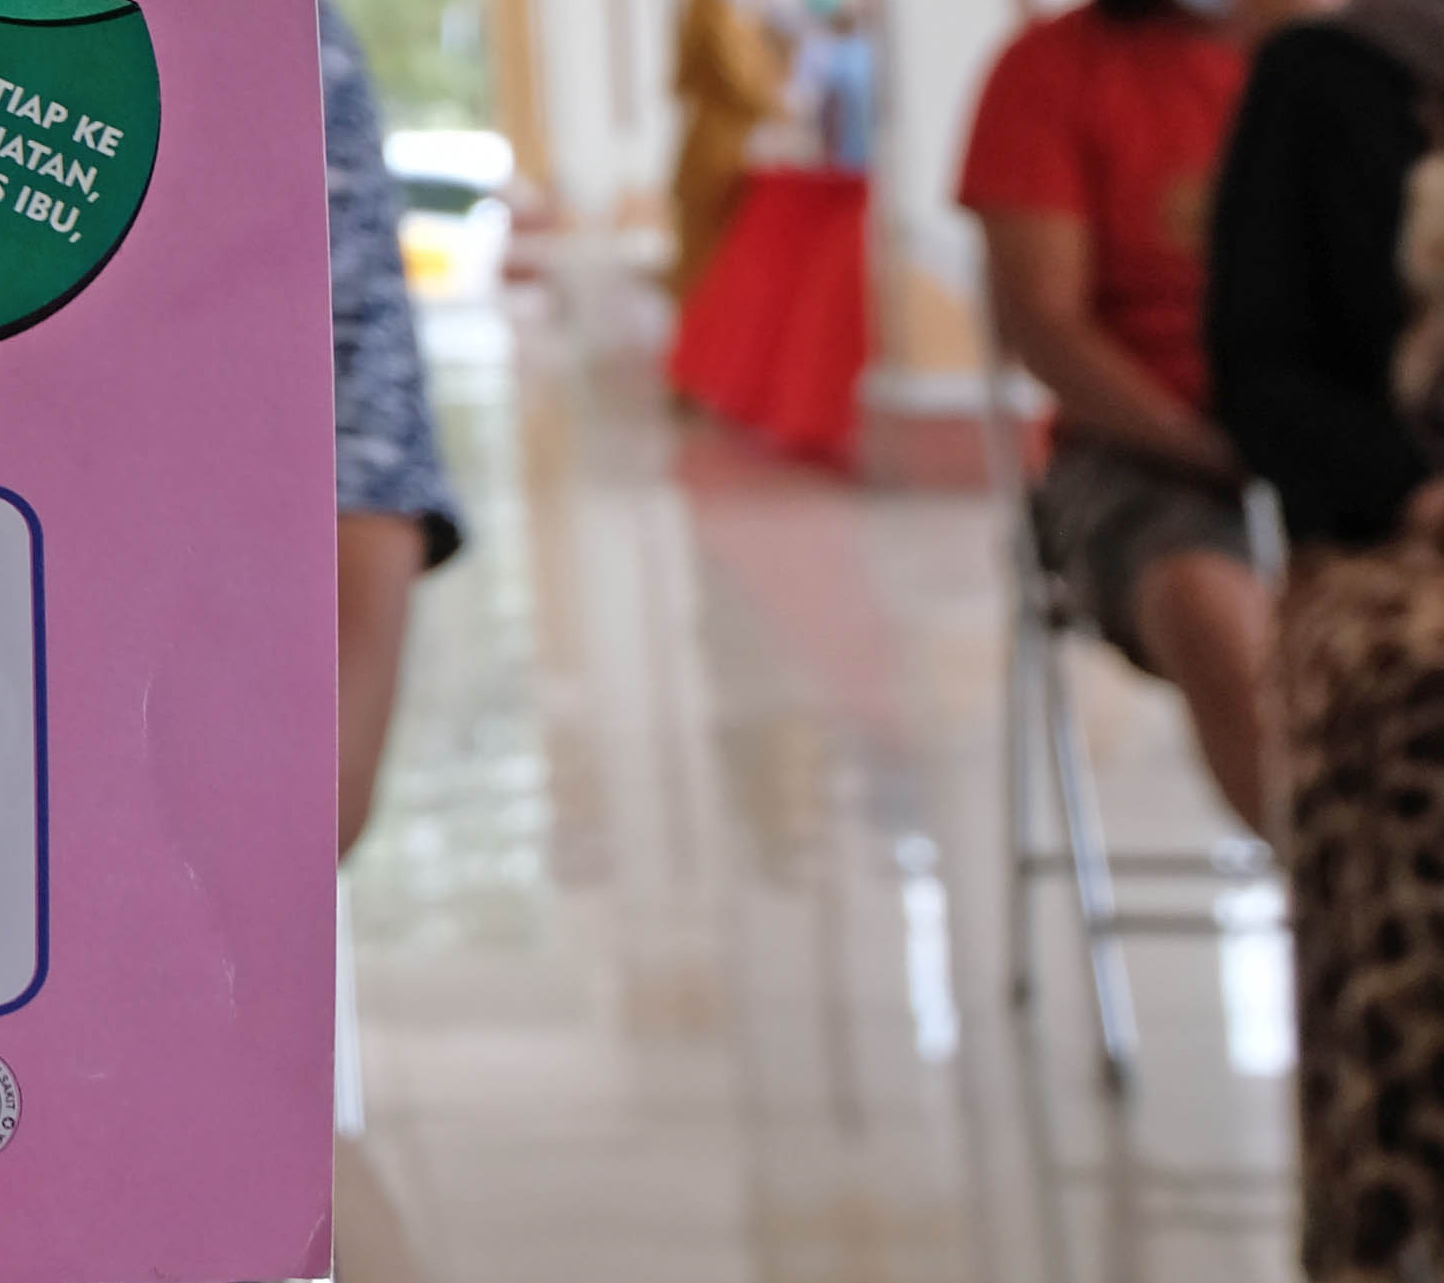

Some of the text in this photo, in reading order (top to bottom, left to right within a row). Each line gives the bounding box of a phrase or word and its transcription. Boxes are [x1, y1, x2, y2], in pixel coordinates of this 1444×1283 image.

[73, 115, 124, 158] KE
[14, 185, 82, 242] IBU,
[0, 1075, 15, 1109] SAKIT
